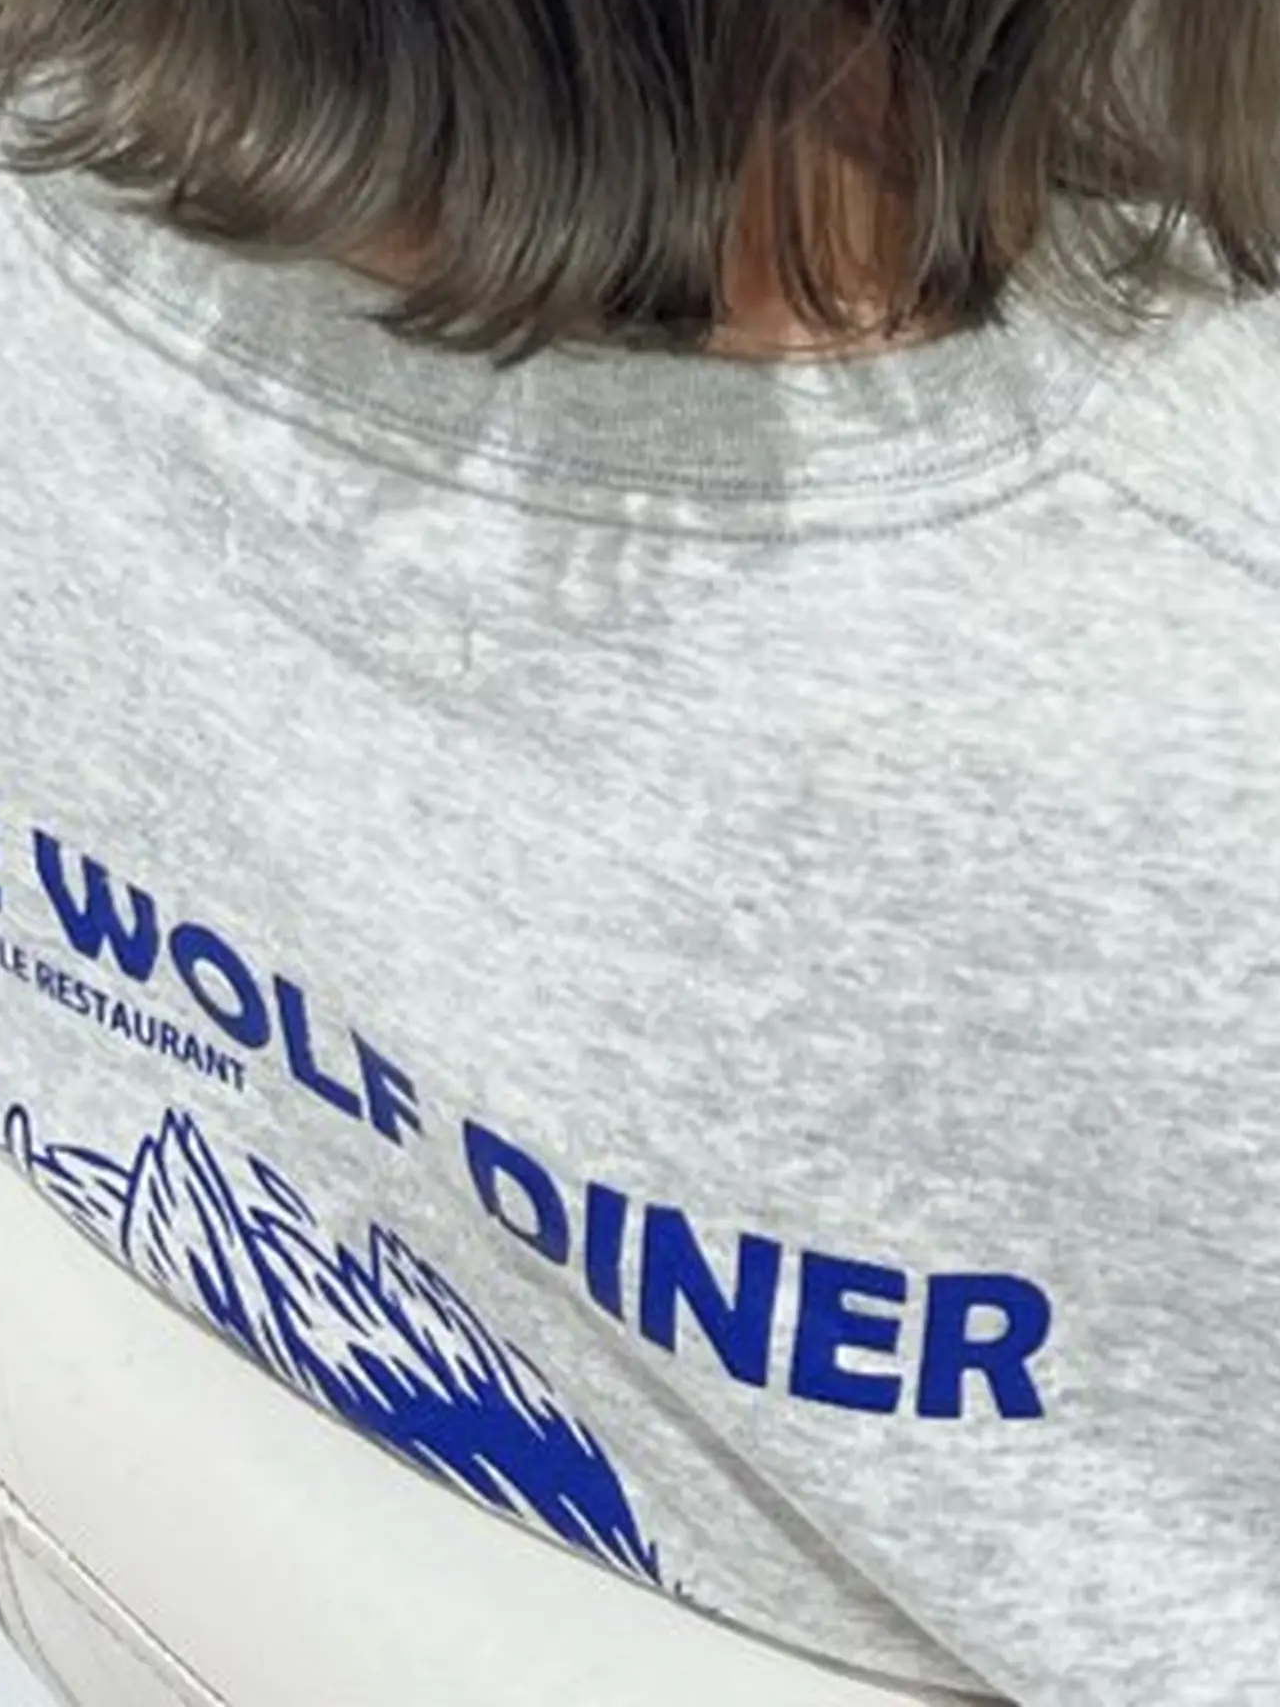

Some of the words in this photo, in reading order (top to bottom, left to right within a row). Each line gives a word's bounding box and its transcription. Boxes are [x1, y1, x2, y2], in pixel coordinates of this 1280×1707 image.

[32, 828, 425, 1147] WOLF
[461, 1118, 1053, 1420] DINER
[34, 960, 248, 1092] RESTAURANT
